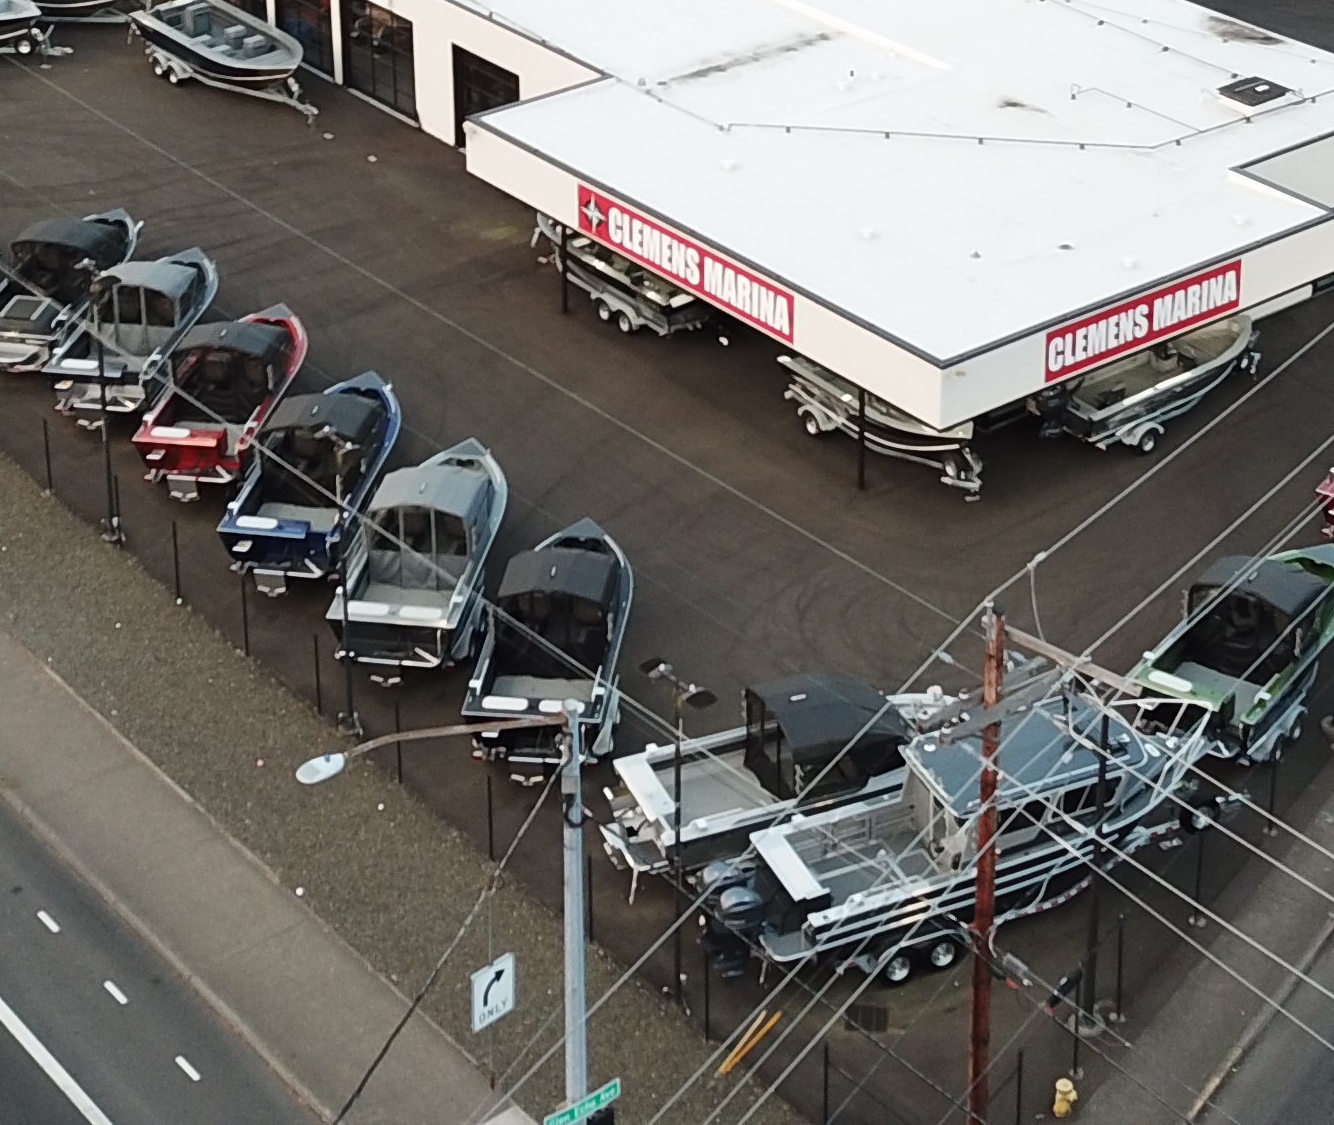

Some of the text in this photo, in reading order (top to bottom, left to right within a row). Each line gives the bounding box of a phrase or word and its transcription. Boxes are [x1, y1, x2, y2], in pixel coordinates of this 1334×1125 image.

[608, 207, 791, 336] CLEMENS MARINA
[1048, 270, 1238, 372] CLEMENS MARINA
[479, 997, 508, 1024] ONLY
